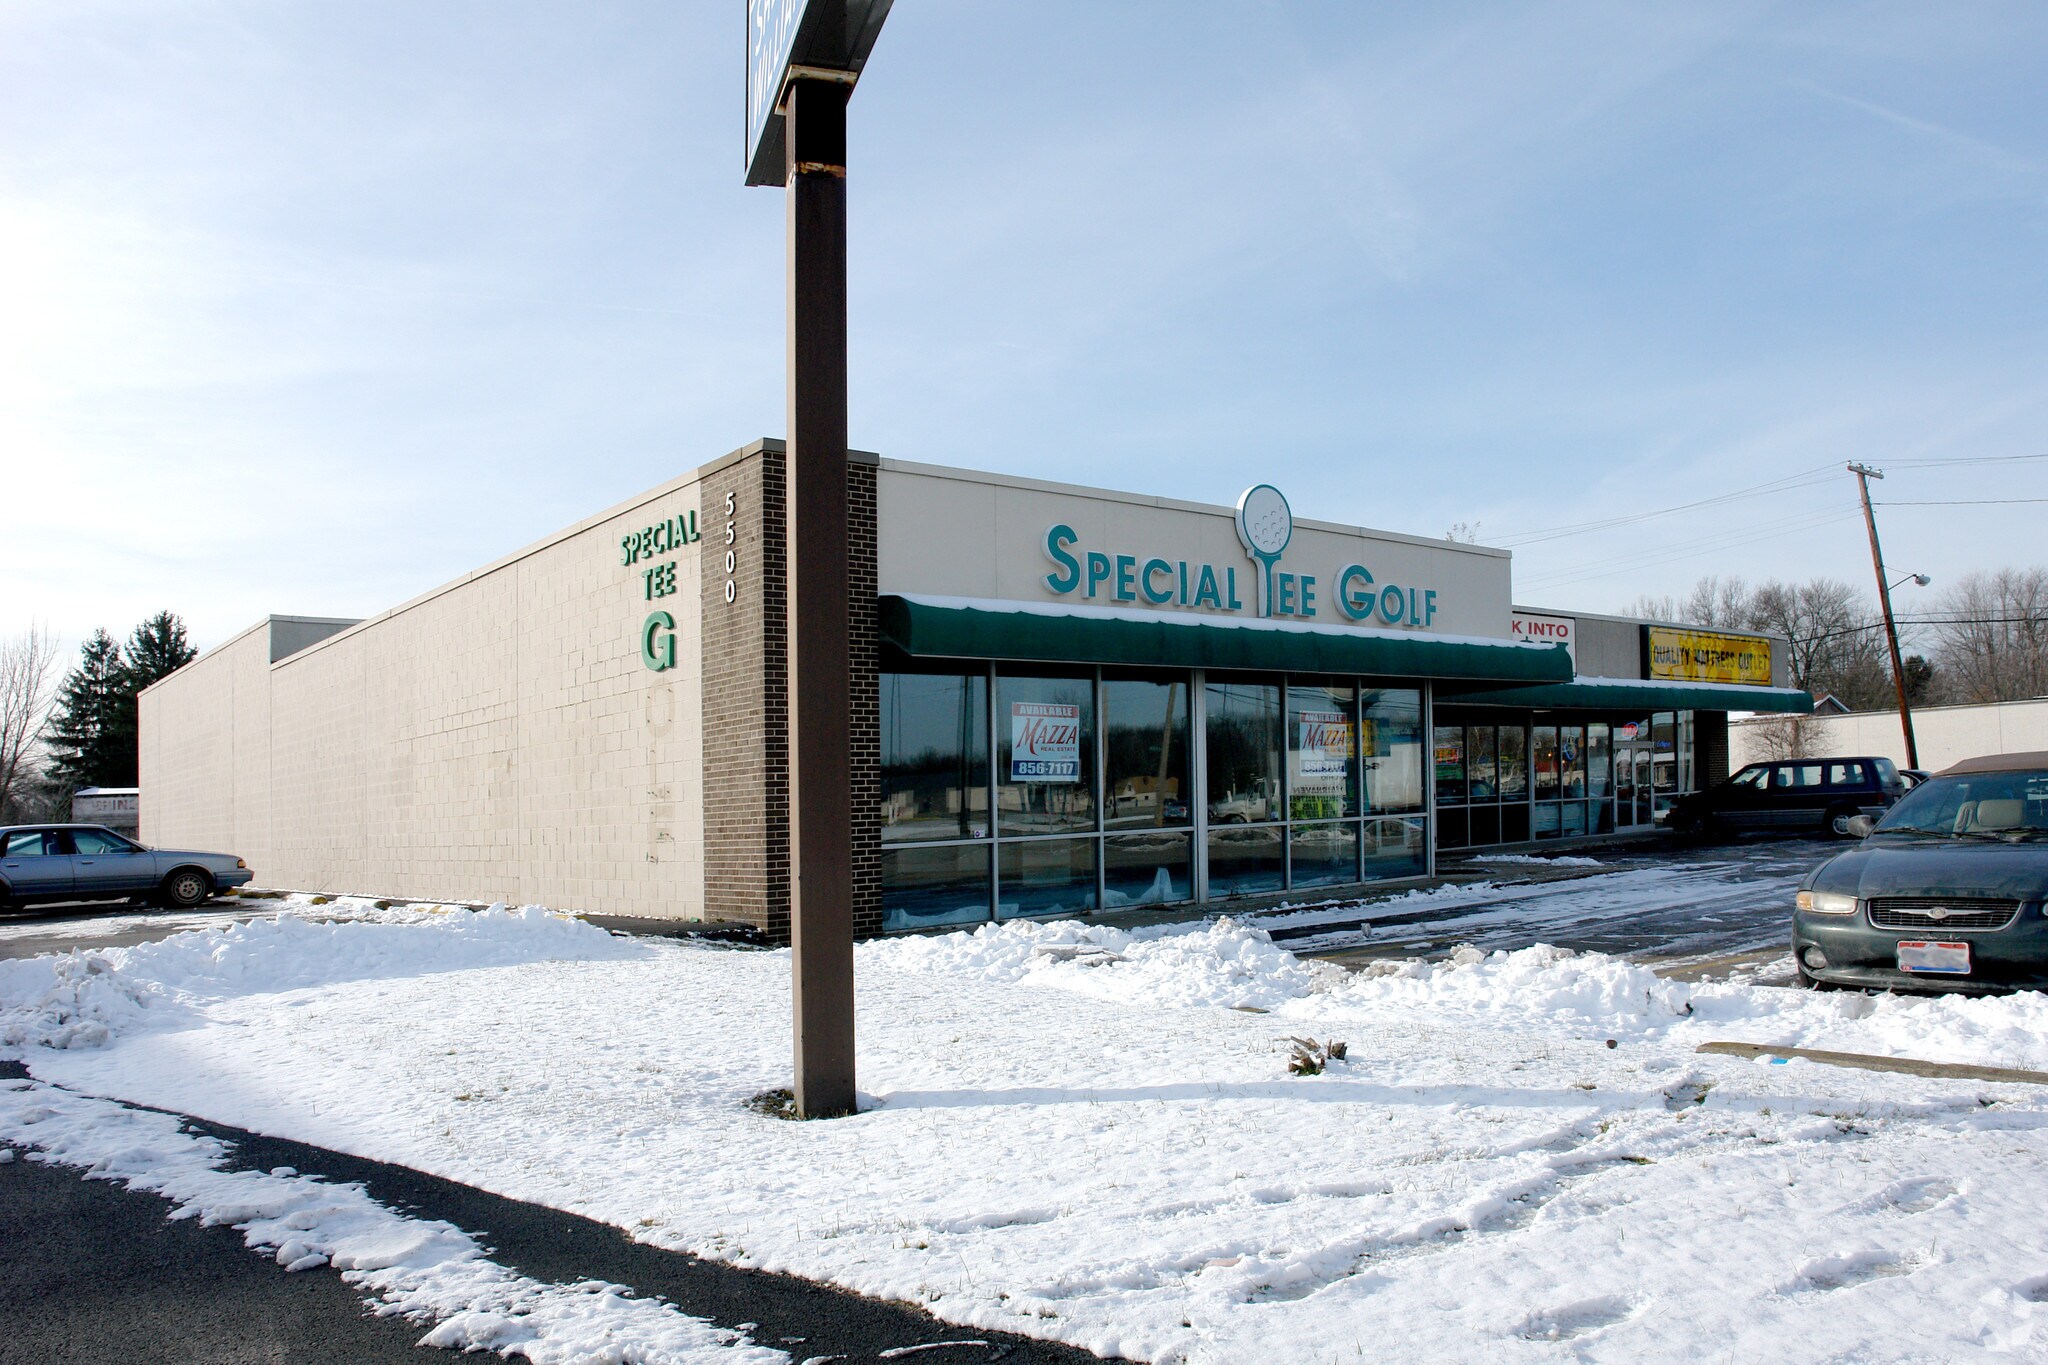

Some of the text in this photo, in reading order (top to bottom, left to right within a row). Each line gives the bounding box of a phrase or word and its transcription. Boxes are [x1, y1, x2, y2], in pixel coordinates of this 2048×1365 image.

[752, 0, 796, 130] WILLIA
[619, 509, 701, 567] SPECIAL
[724, 491, 736, 603] 5500
[641, 561, 677, 601] TEE
[1041, 524, 1242, 610] SPECIAL
[1333, 563, 1437, 627] GOLF
[1528, 621, 1569, 637] INTO
[1654, 644, 1690, 665] QUALITY
[1020, 705, 1073, 717] AVAILABLE
[1016, 718, 1077, 756] MAZZA
[1302, 724, 1345, 752] MAZZA
